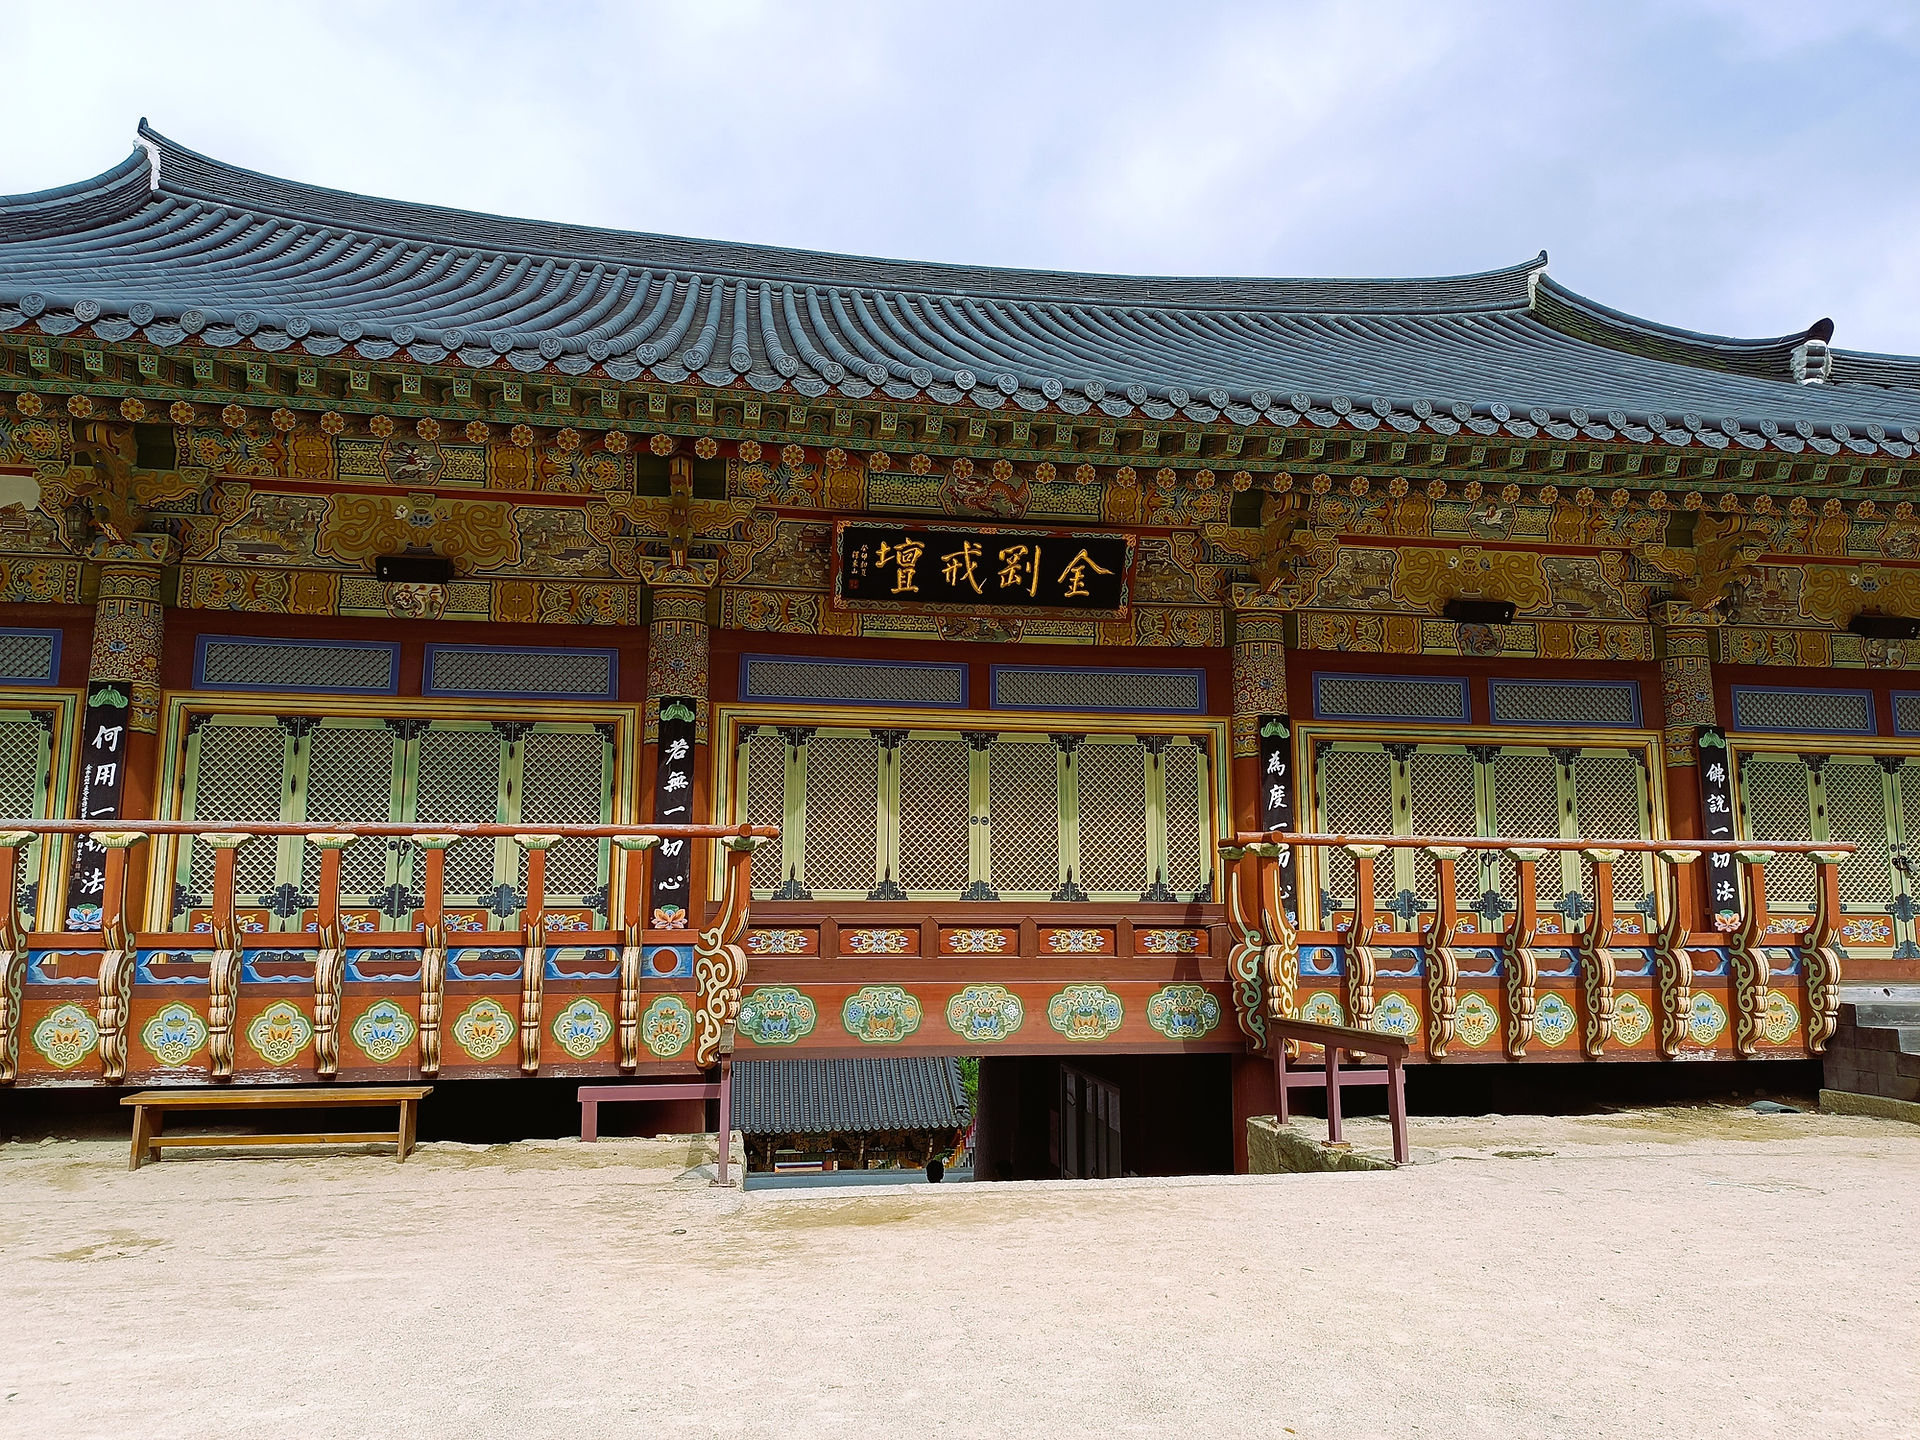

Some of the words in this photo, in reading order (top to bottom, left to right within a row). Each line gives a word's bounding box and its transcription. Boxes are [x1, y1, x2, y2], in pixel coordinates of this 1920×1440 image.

[80, 725, 122, 894] 何用一切法
[658, 738, 690, 891] 若無一切心
[1706, 762, 1736, 902] 佛說一切法
